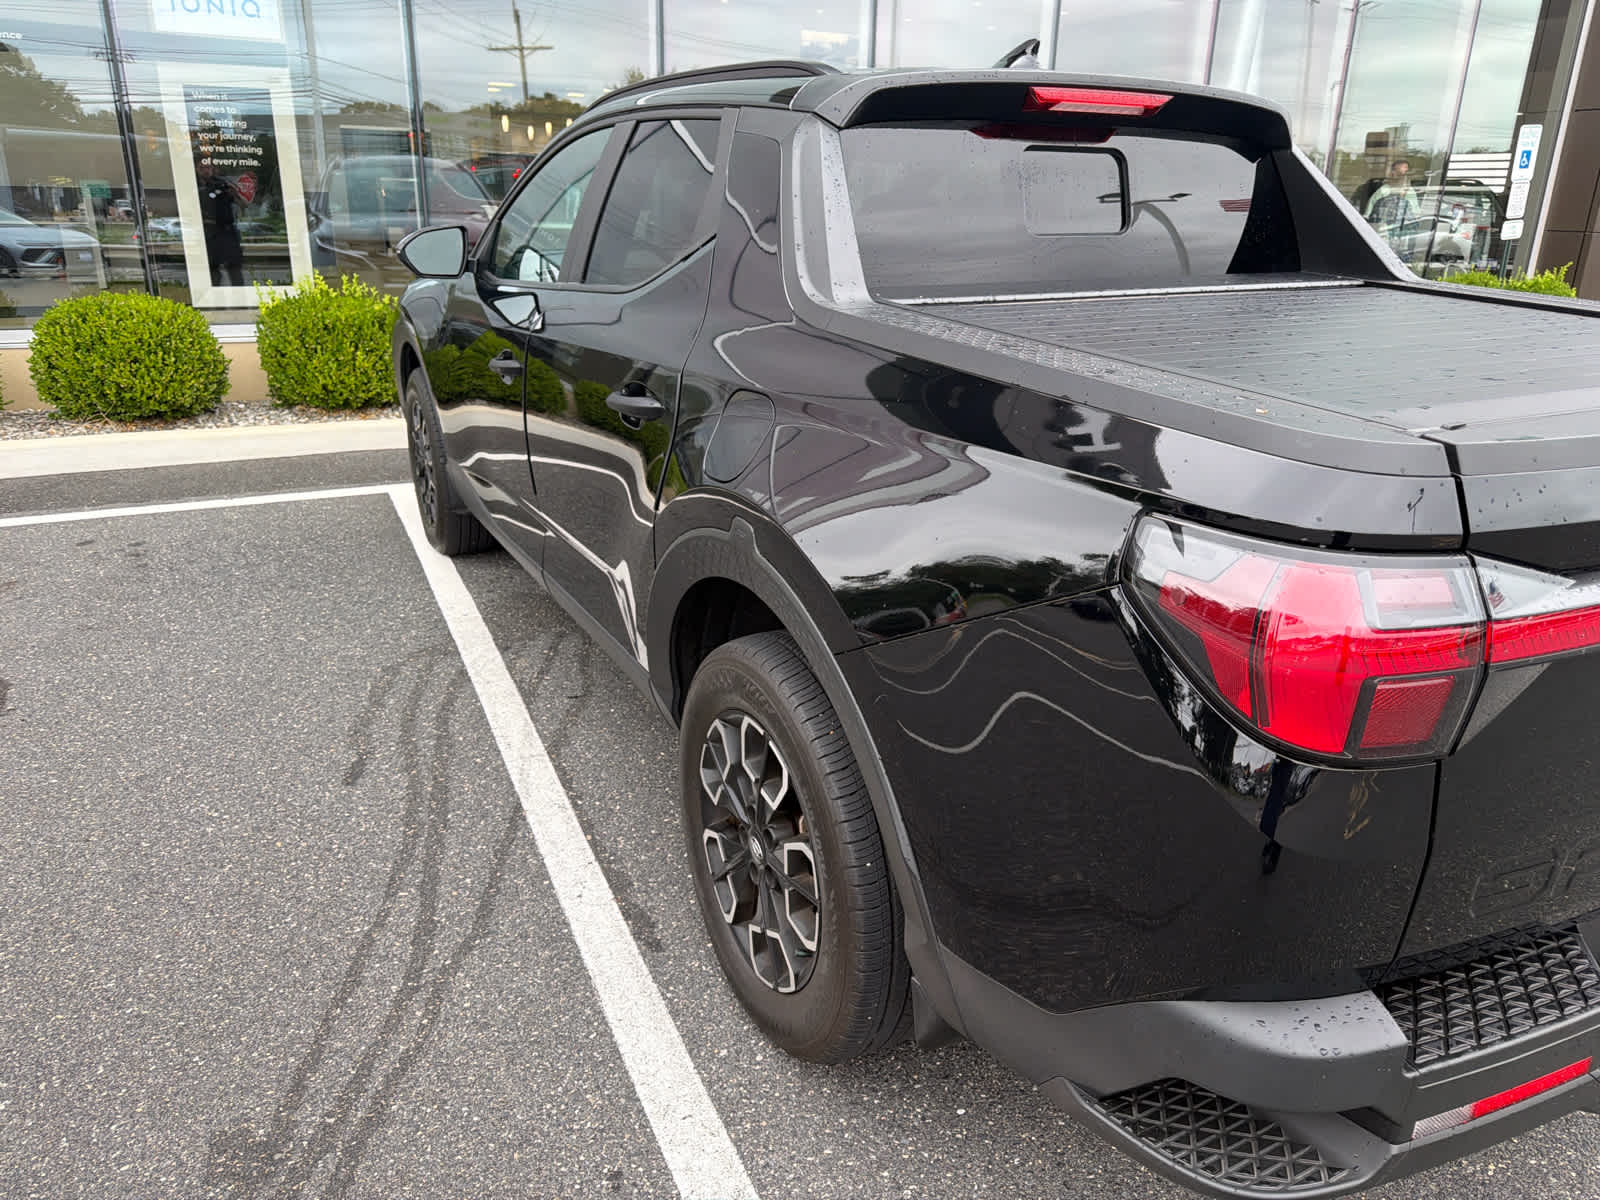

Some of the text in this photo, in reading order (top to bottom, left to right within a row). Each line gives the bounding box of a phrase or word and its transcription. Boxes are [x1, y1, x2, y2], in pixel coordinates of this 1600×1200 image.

[170, 0, 261, 18] IONIQ
[194, 105, 237, 114] comes to
[198, 131, 256, 142] your journey,
[200, 145, 263, 156] we're thinking
[201, 158, 261, 168] of every mile.
